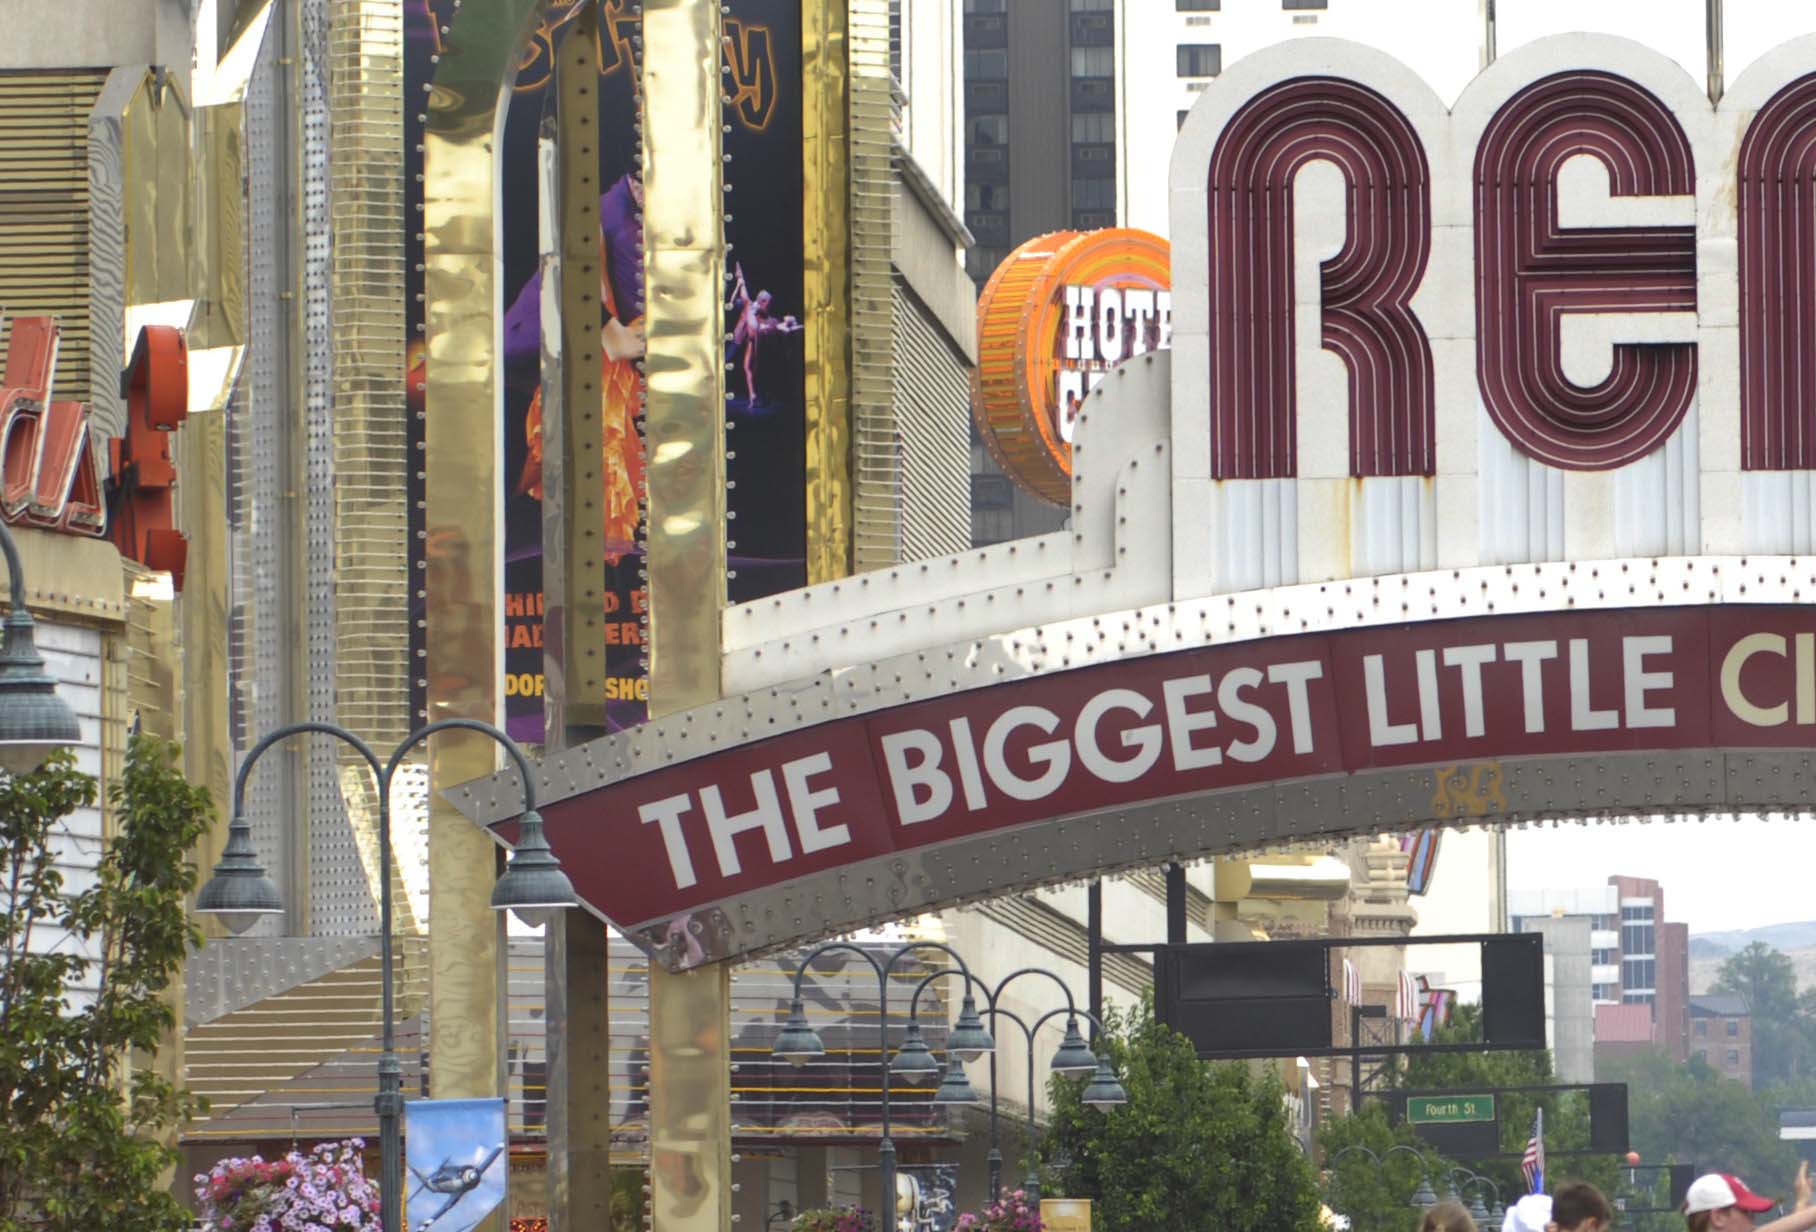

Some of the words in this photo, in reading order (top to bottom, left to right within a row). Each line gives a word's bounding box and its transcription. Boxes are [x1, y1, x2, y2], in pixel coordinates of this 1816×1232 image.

[637, 750, 853, 890] THE
[880, 658, 1325, 827] BIGGEST
[1363, 634, 1677, 748] LITTLE
[1425, 1103, 1458, 1116] Fourth
[1464, 1102, 1476, 1114] St
